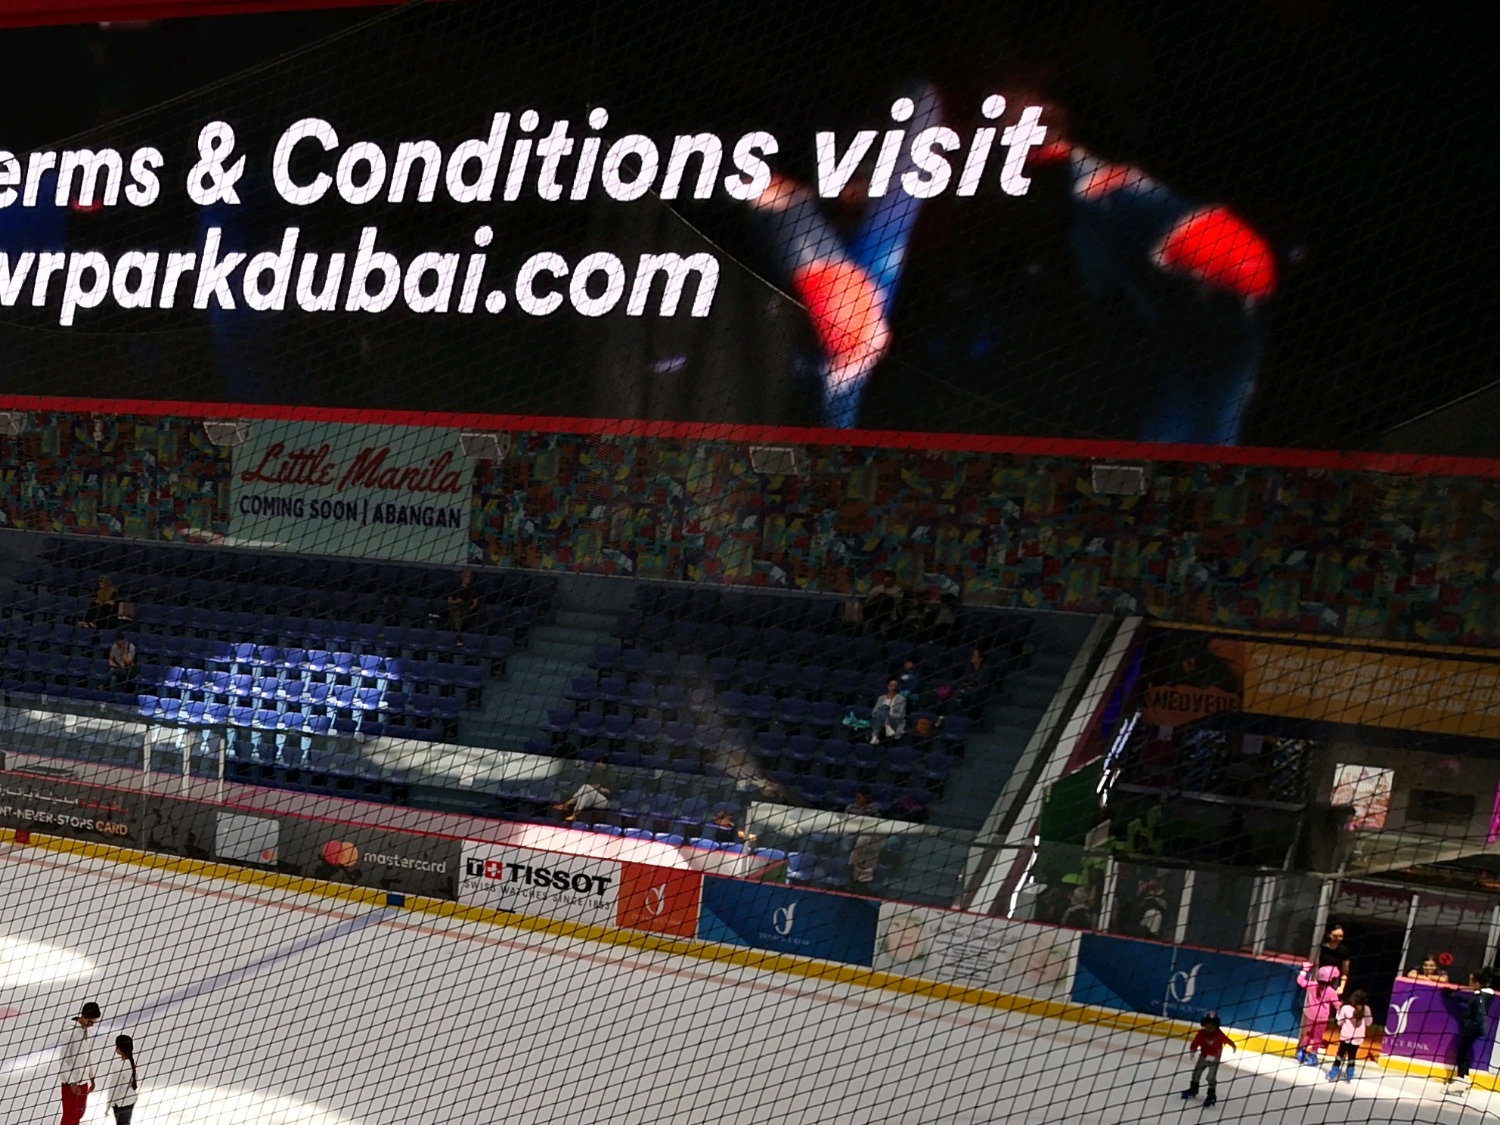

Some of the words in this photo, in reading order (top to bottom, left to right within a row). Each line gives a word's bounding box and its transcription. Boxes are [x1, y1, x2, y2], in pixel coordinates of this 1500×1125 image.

[187, 121, 246, 206] &
[273, 107, 782, 206] Conditions
[815, 94, 1048, 199] visit
[240, 441, 336, 487] Little
[337, 447, 463, 494] Manila
[239, 495, 305, 519] COMING
[309, 499, 358, 522] SOON
[372, 502, 461, 529] ABANGAN
[94, 820, 129, 836] CARD
[363, 851, 447, 874] mastercard
[463, 878, 497, 894] SWISS
[500, 884, 548, 901] WATCHES
[552, 893, 585, 907] SINCE
[505, 863, 612, 896] TISSOT
